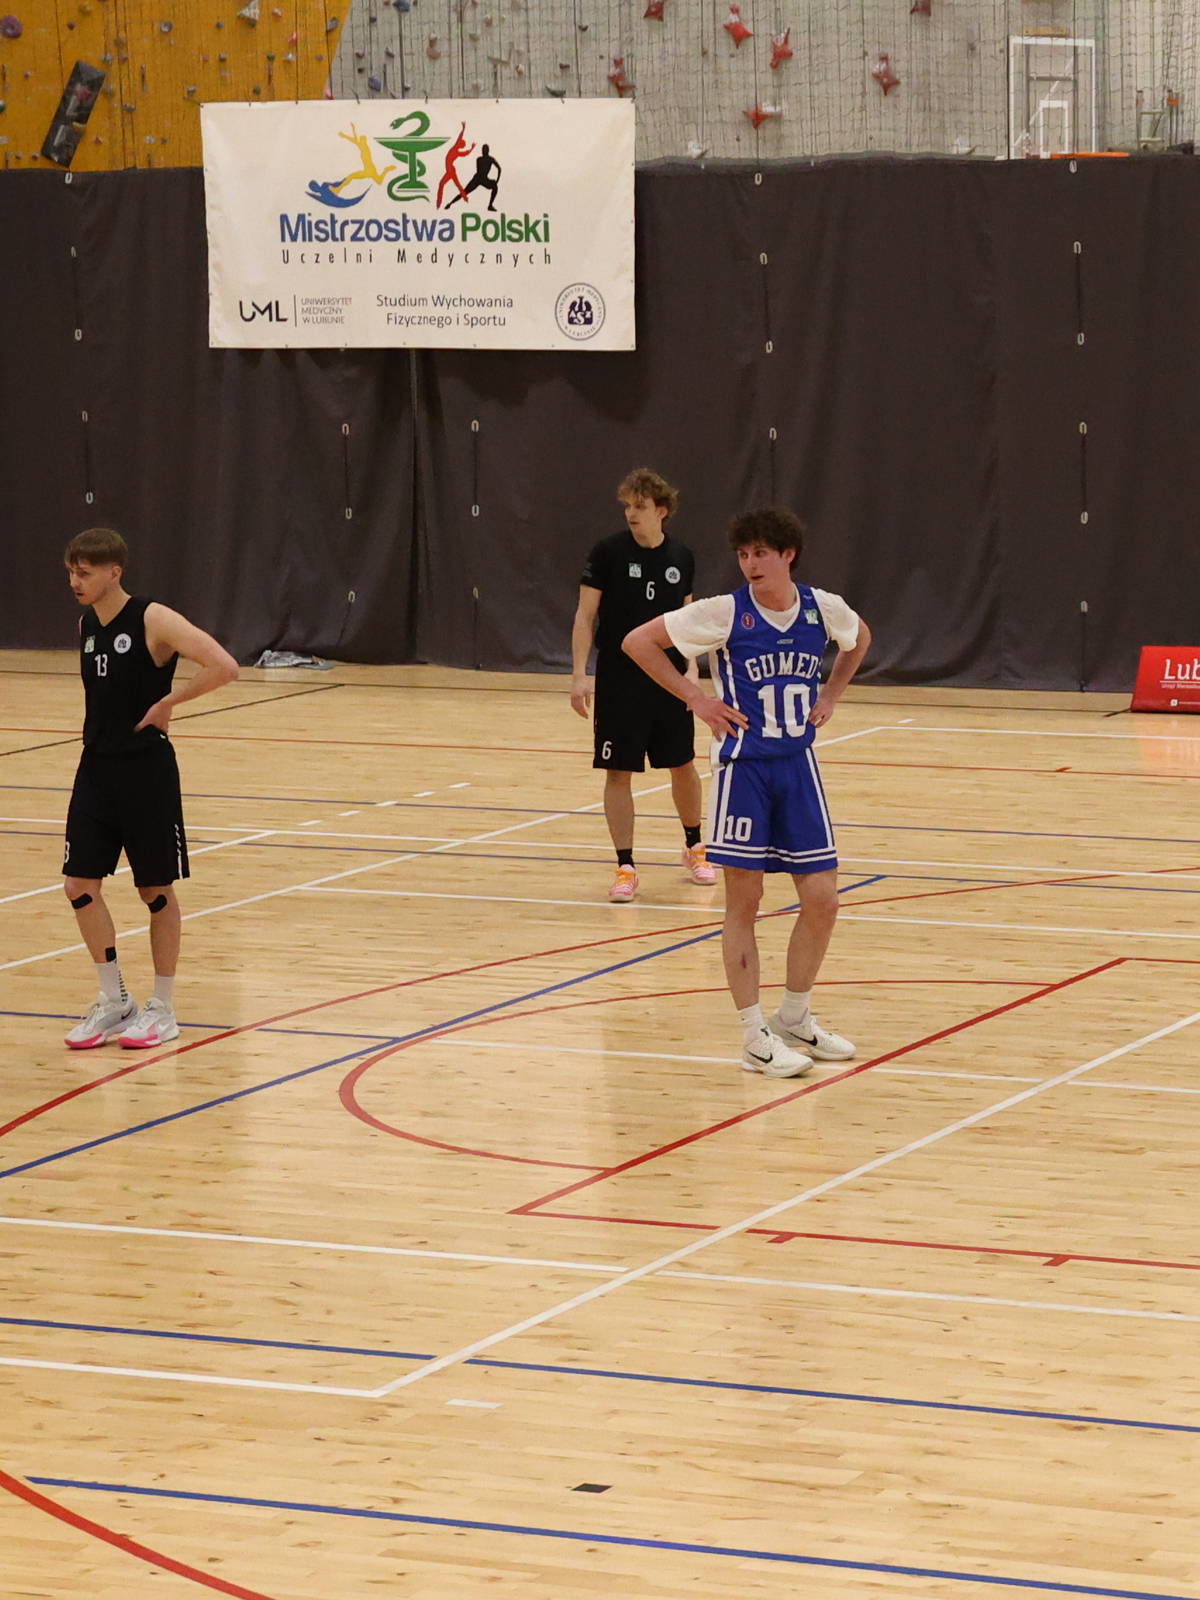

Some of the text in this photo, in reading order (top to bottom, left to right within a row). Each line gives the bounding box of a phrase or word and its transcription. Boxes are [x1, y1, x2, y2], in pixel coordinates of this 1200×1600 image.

[280, 212, 550, 243] Mistrzostwa Polski
[282, 247, 551, 268] Uczelni Medycznych
[301, 297, 352, 306] UNIWERSYTET
[376, 294, 514, 310] Studium Wychowania
[386, 312, 506, 328] Fizycznego i Sportu
[646, 581, 655, 600] 6
[94, 653, 108, 677] 13
[745, 652, 819, 682] GUMED
[757, 683, 811, 738] 10
[602, 740, 612, 760] 6
[724, 814, 753, 842] 10
